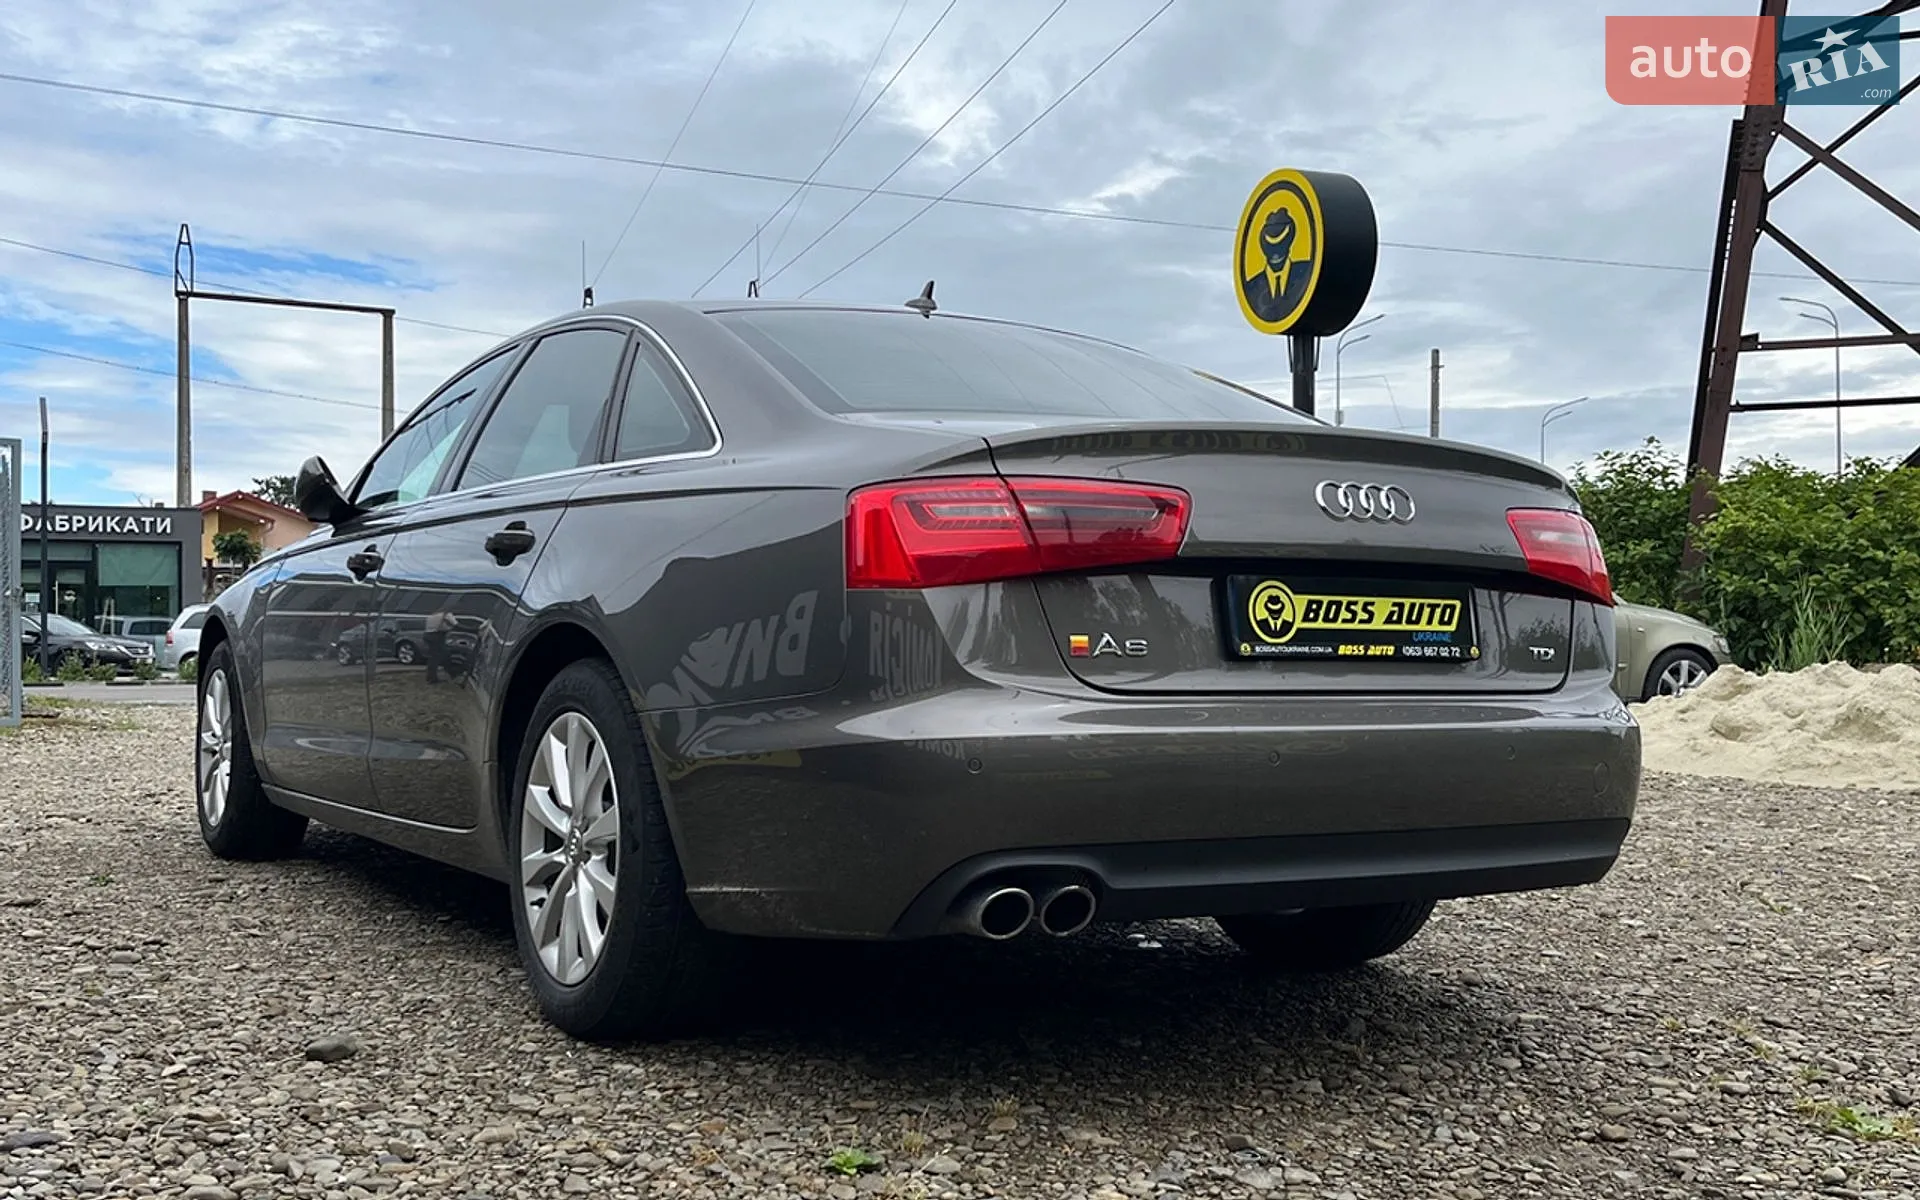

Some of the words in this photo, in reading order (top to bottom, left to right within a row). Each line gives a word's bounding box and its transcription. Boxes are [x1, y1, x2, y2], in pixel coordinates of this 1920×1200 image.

[1301, 599, 1376, 624] BOSS
[1383, 601, 1458, 626] AUTO
[1412, 631, 1452, 643] UKRAINE
[1092, 632, 1149, 657] A6
[1337, 644, 1365, 655] BOSS
[1367, 645, 1395, 656] AUTO
[1450, 647, 1460, 658] 72
